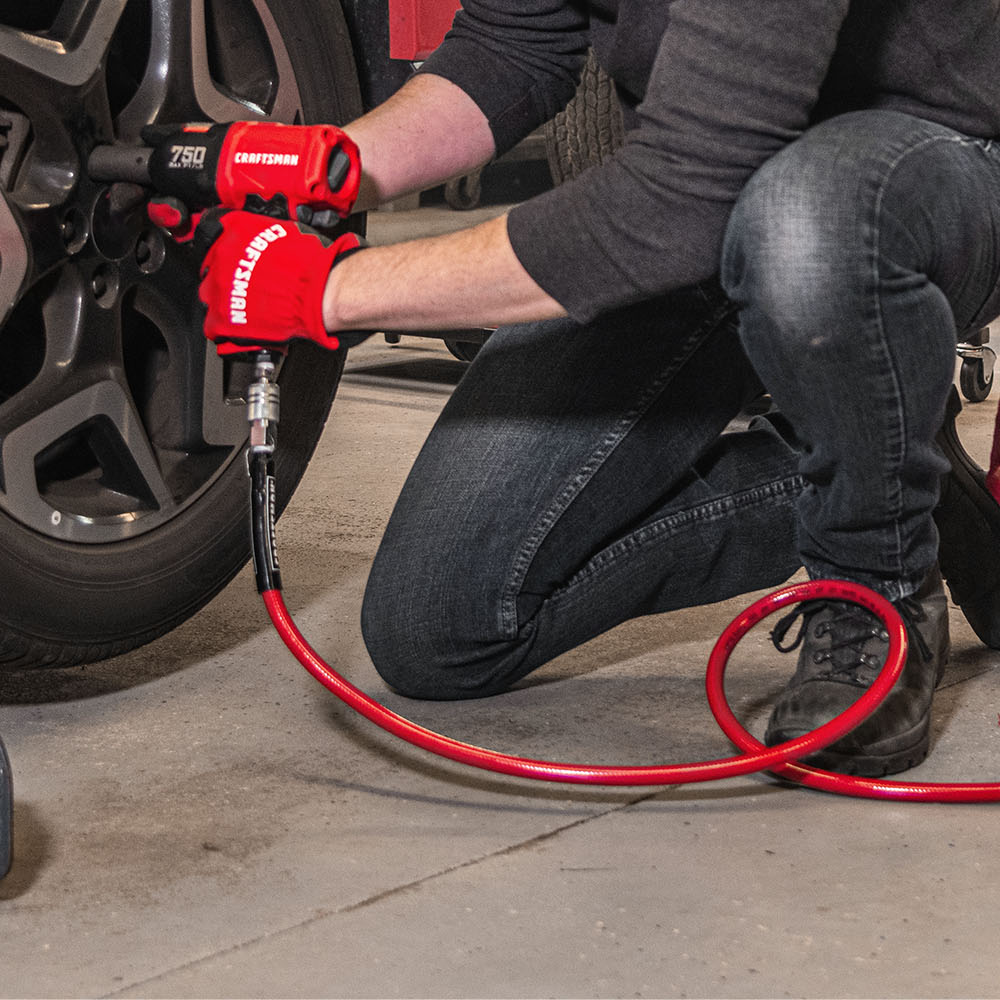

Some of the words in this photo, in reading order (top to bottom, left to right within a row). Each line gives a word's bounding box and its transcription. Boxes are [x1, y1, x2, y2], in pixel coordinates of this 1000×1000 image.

[171, 145, 207, 163] 750
[234, 152, 299, 166] CRAFTSMAN
[230, 223, 287, 325] CRAFTSMAN
